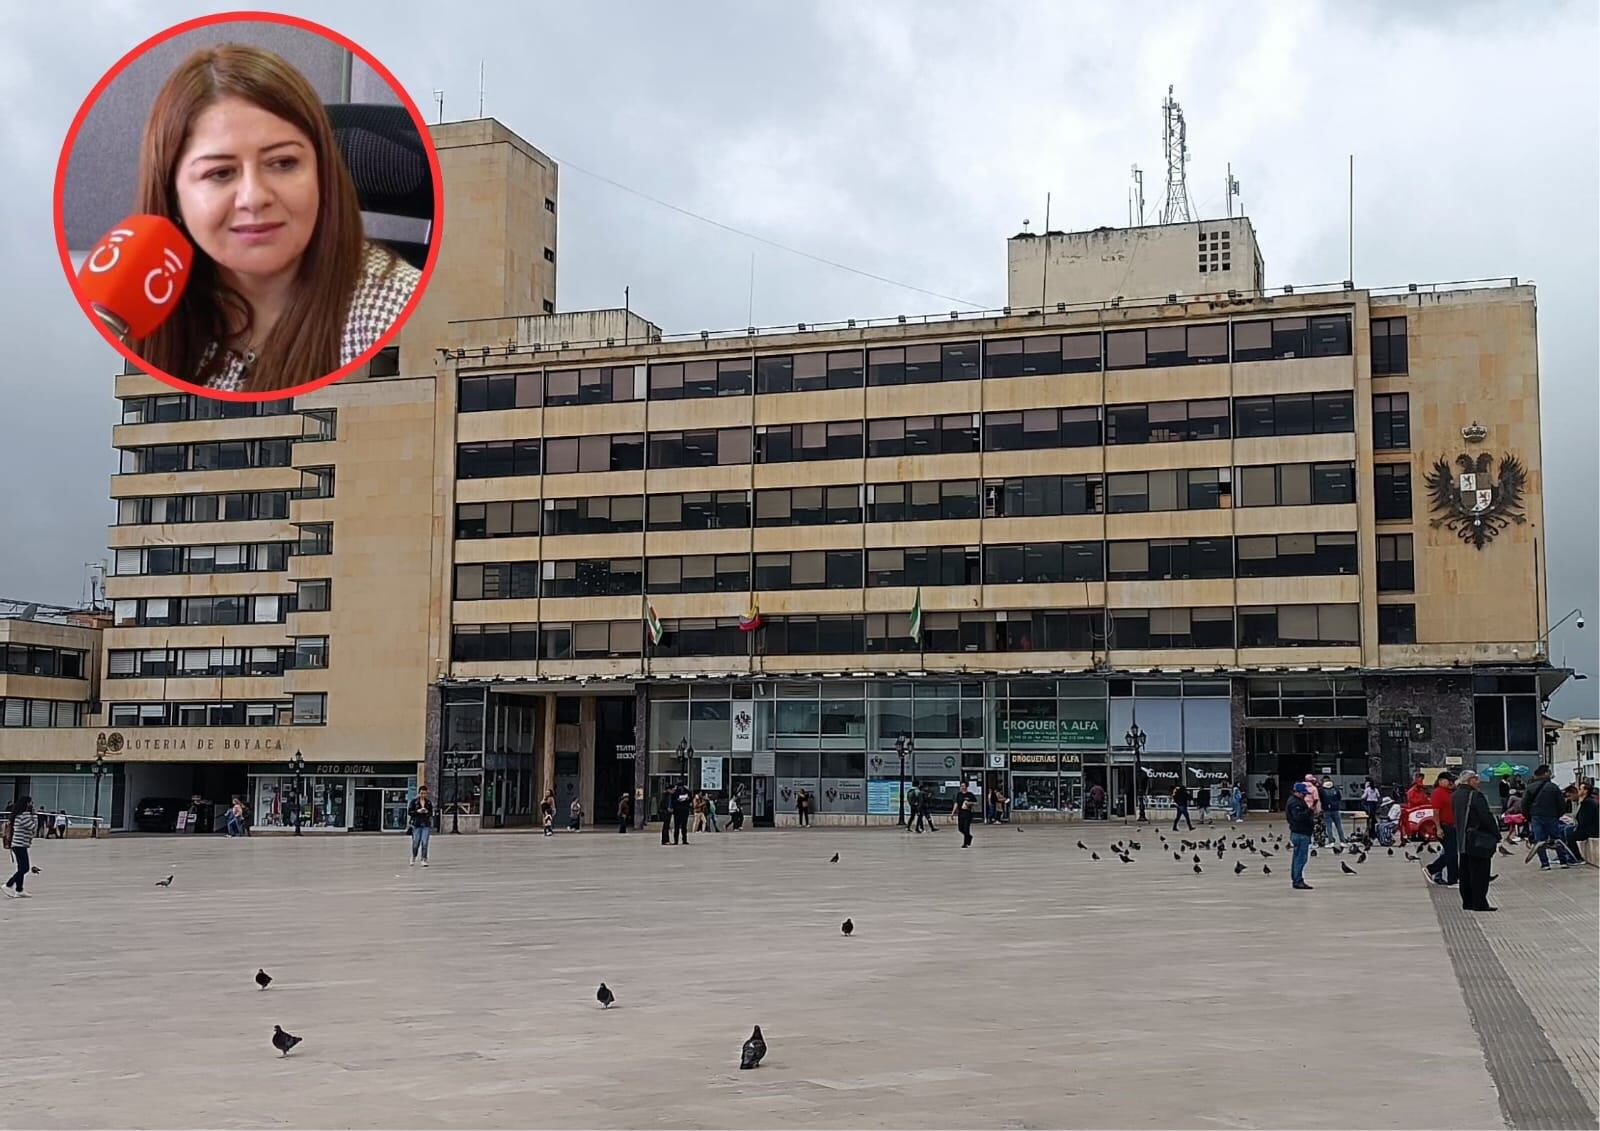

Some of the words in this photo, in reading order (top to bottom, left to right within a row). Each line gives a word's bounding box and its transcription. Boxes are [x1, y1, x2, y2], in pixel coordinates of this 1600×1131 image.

[1003, 720, 1068, 730] DROGUERA
[1071, 720, 1099, 731] ALFA
[126, 739, 187, 750] LOTERIA
[197, 739, 214, 750] DE
[224, 738, 282, 750] BOYACA
[1061, 755, 1080, 763] ALFA
[316, 764, 340, 774] FOTO
[343, 764, 376, 774] DIGITAL
